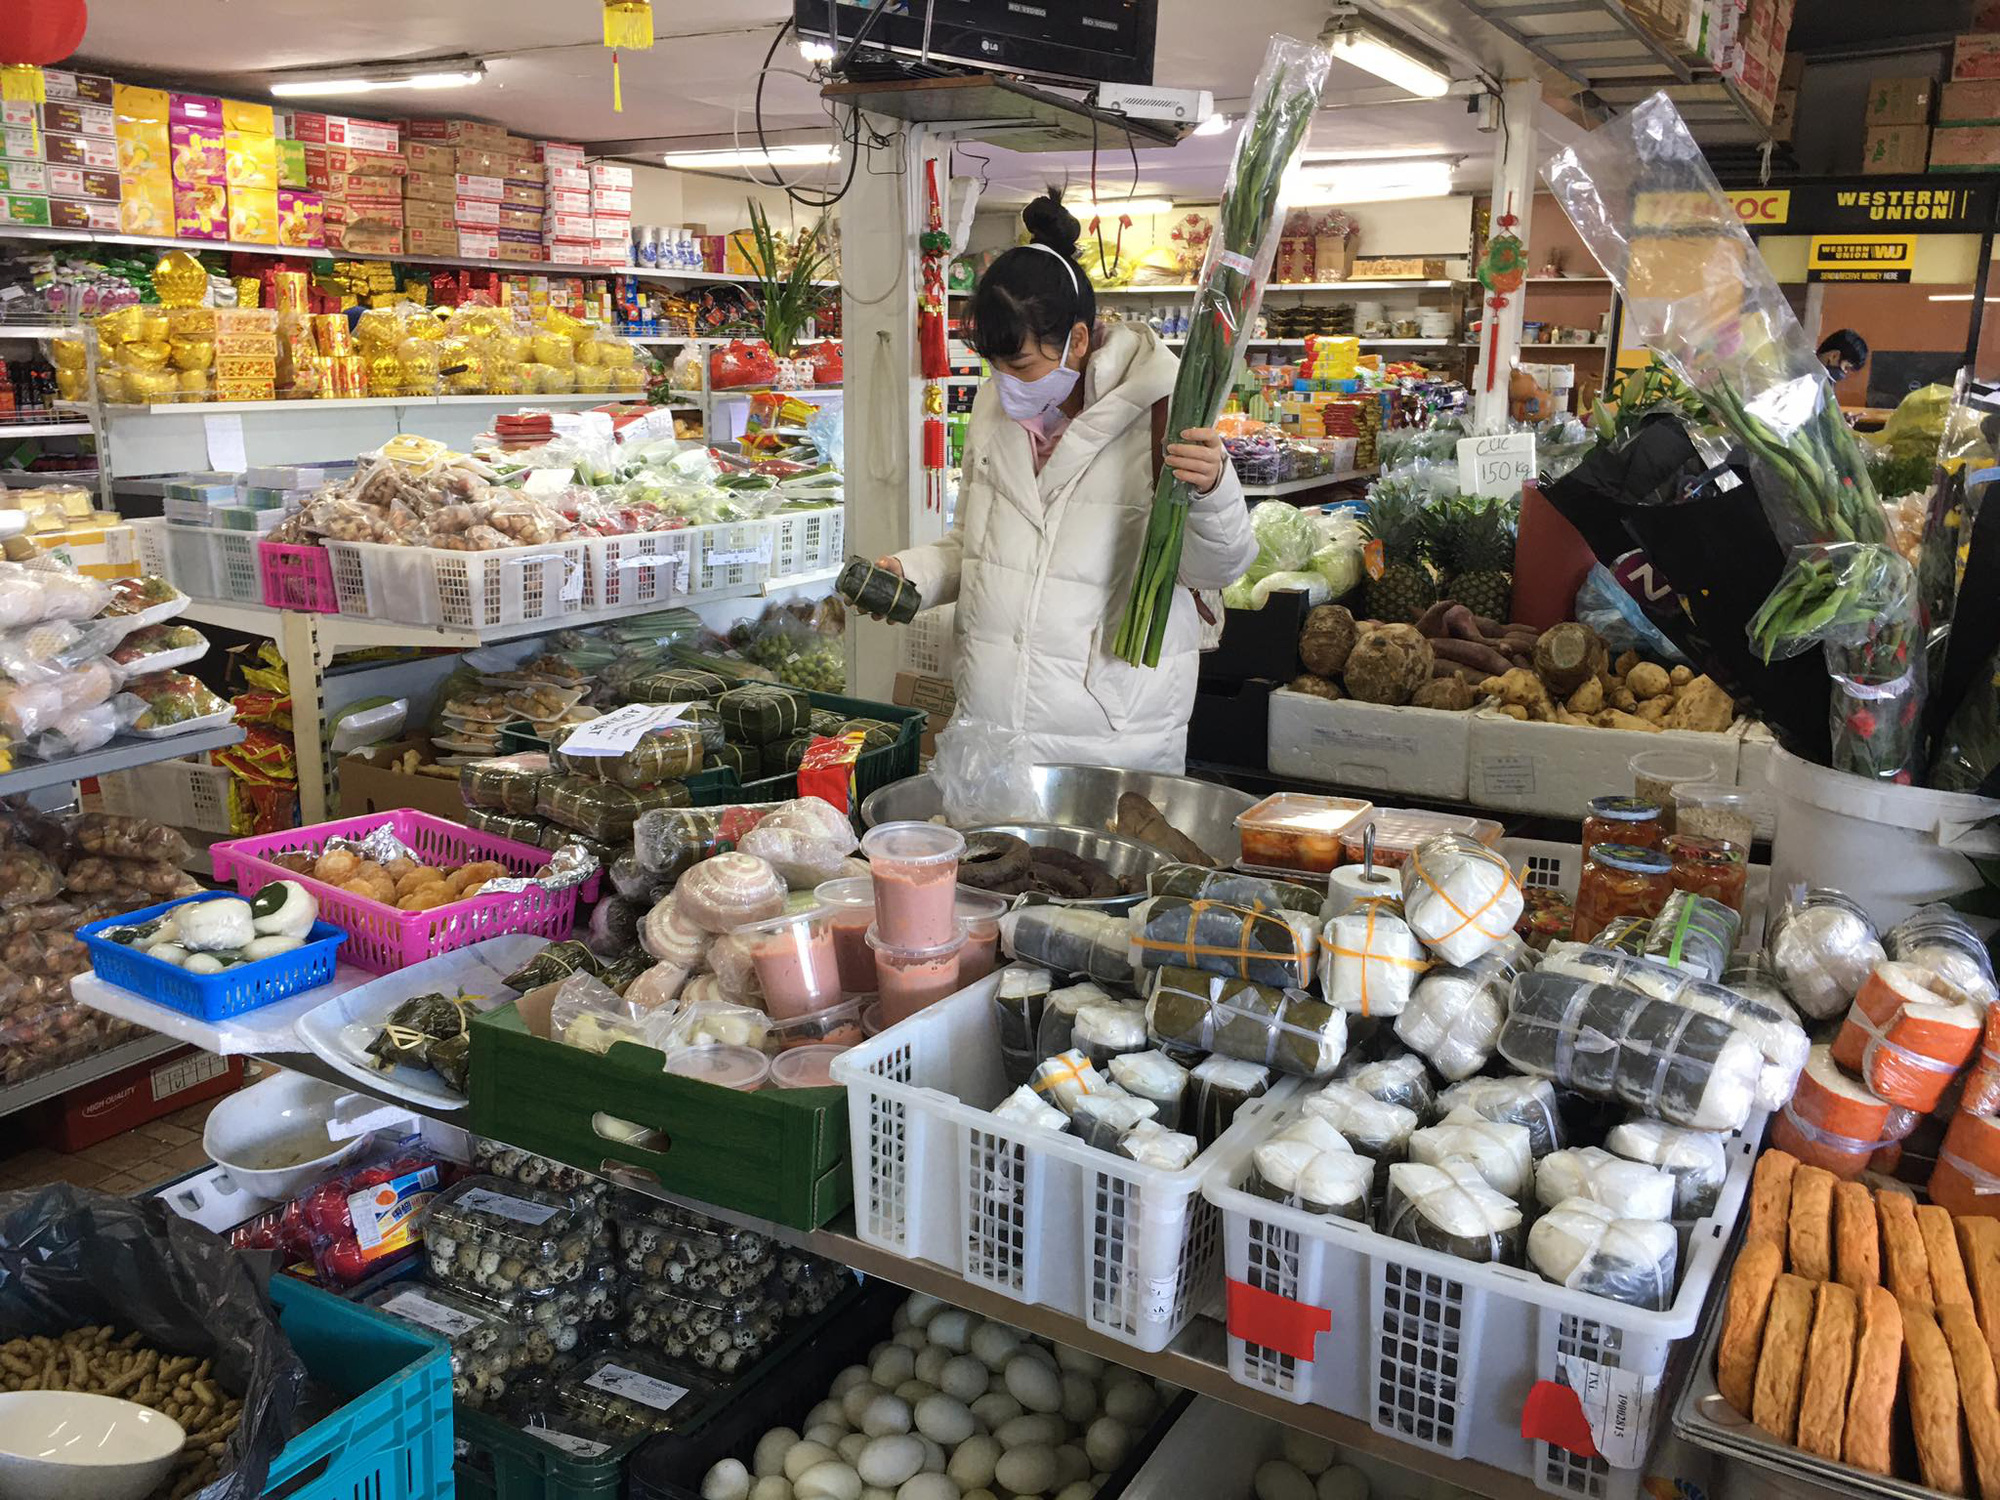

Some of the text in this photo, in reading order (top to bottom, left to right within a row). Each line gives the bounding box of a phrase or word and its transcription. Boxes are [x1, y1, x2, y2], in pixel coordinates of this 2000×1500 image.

[1837, 190, 1950, 206] WESTERN
[1870, 205, 1949, 220] UNION
[1821, 245, 1870, 253] WESTERN
[1482, 461, 1511, 485] 150
[86, 1085, 137, 1115] HIGH QUALITY
[1613, 1394, 1629, 1439] 19002815
